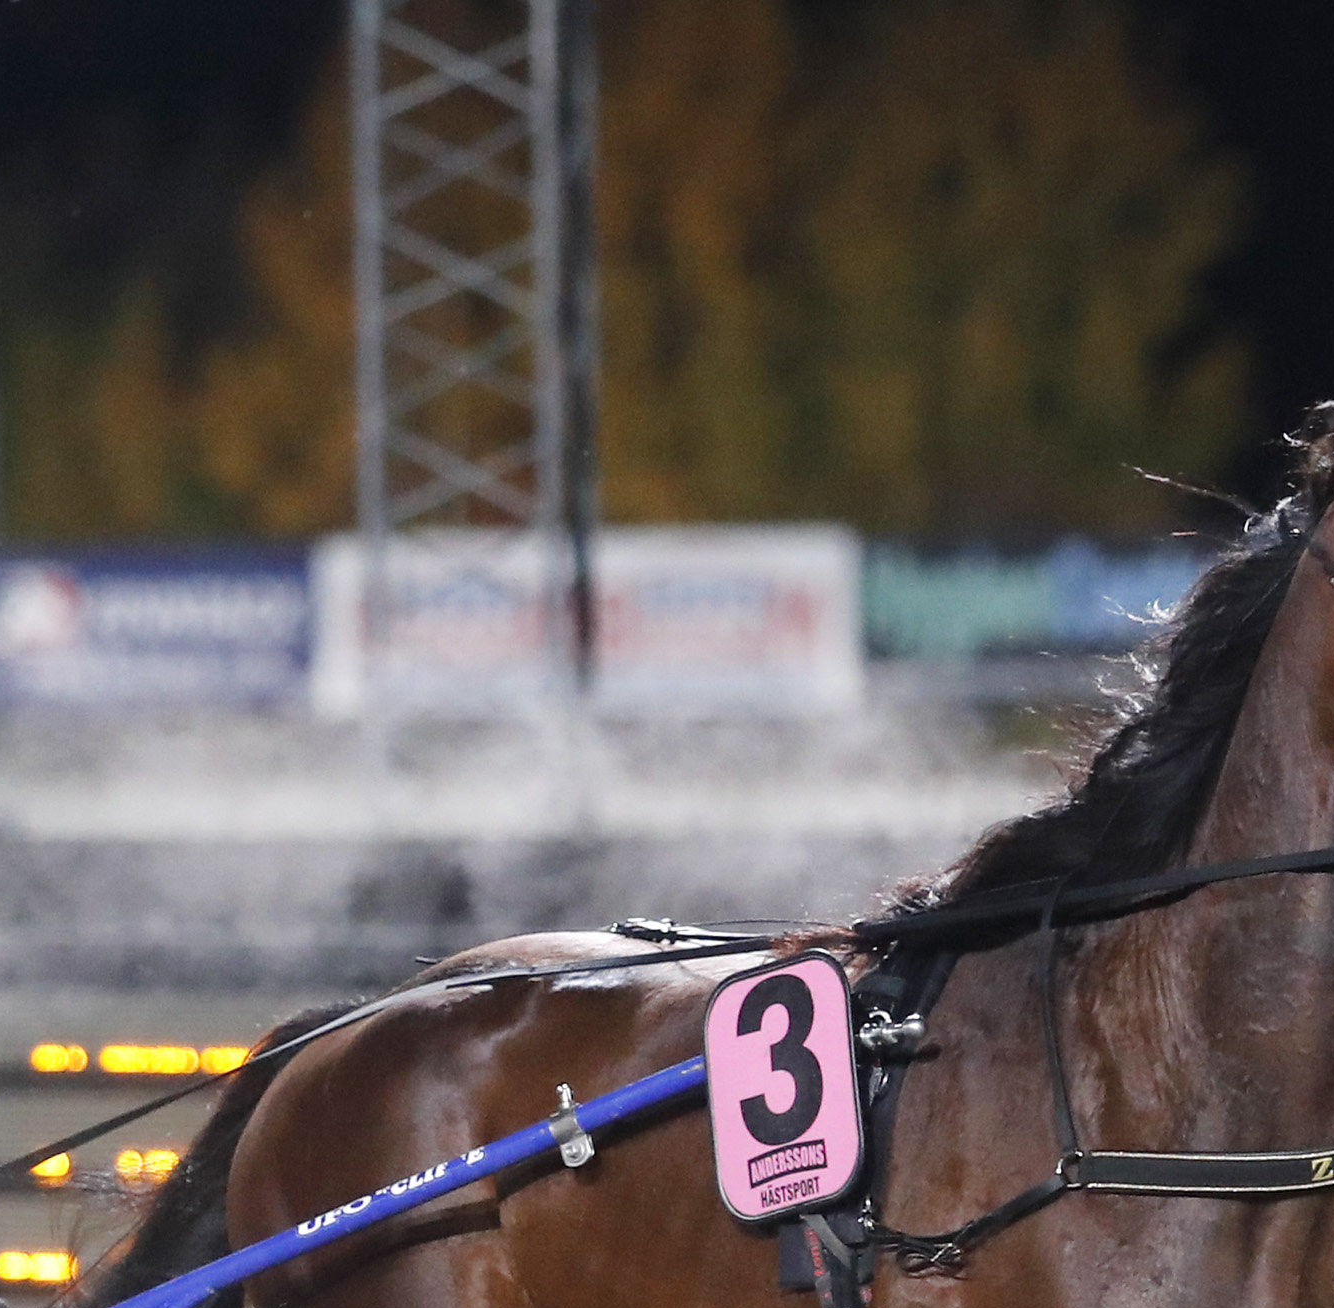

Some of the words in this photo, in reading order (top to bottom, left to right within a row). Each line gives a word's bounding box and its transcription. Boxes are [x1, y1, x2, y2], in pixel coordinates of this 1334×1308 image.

[737, 974, 824, 1147] 3
[750, 1143, 825, 1185] ANDERSSONS
[761, 1176, 820, 1208] HÄSTSPORT
